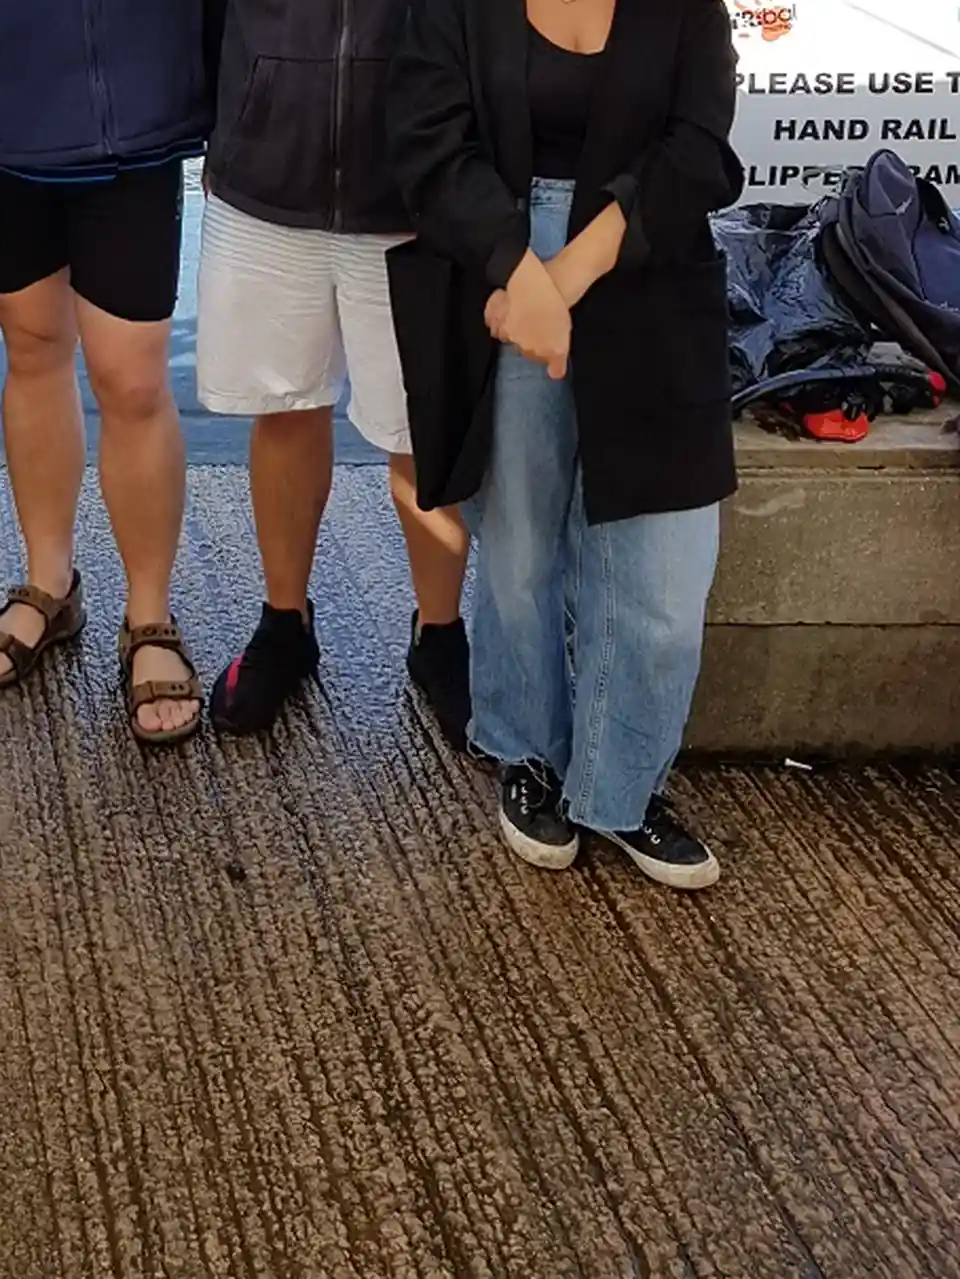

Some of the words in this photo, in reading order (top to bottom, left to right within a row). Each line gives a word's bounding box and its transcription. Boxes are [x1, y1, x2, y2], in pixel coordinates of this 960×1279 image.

[869, 73, 934, 94] USE
[773, 119, 870, 141] HAND
[881, 119, 957, 140] RAIL
